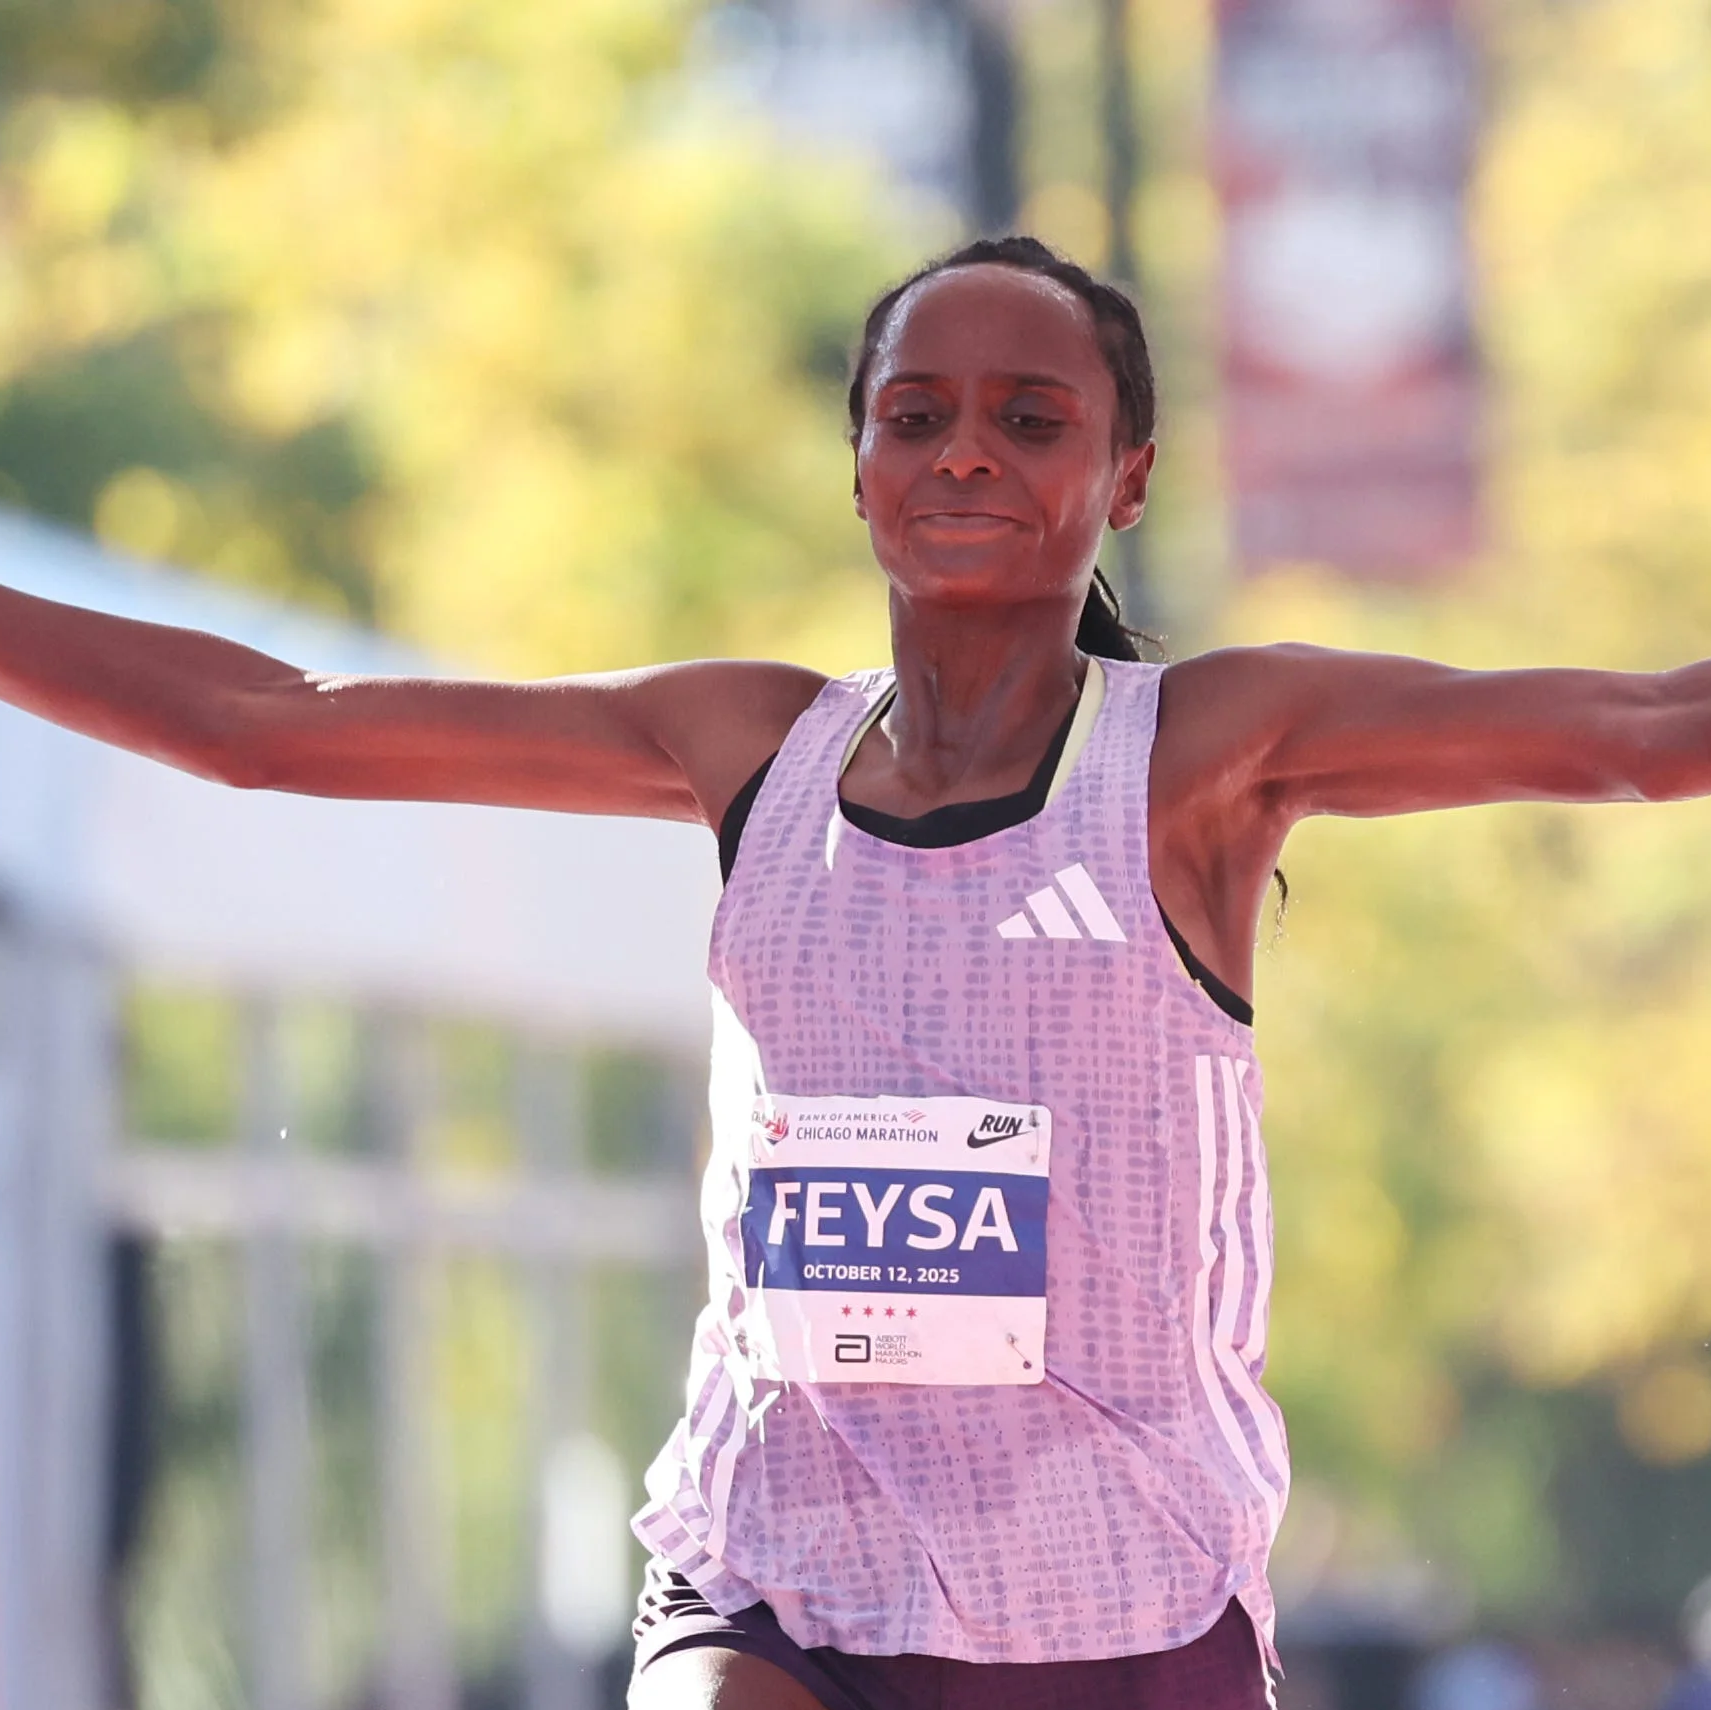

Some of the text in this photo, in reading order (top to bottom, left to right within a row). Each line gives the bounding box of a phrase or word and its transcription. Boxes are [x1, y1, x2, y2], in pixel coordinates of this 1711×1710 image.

[798, 1113, 898, 1123] BANK OF AMERICA
[979, 1114, 1023, 1135] RUN
[796, 1126, 939, 1143] CHICAGO MARATHON
[767, 1181, 1019, 1252] FEYSA
[803, 1263, 961, 1284] OCTOBER 12, 2025
[875, 1350, 922, 1358] MARATHON
